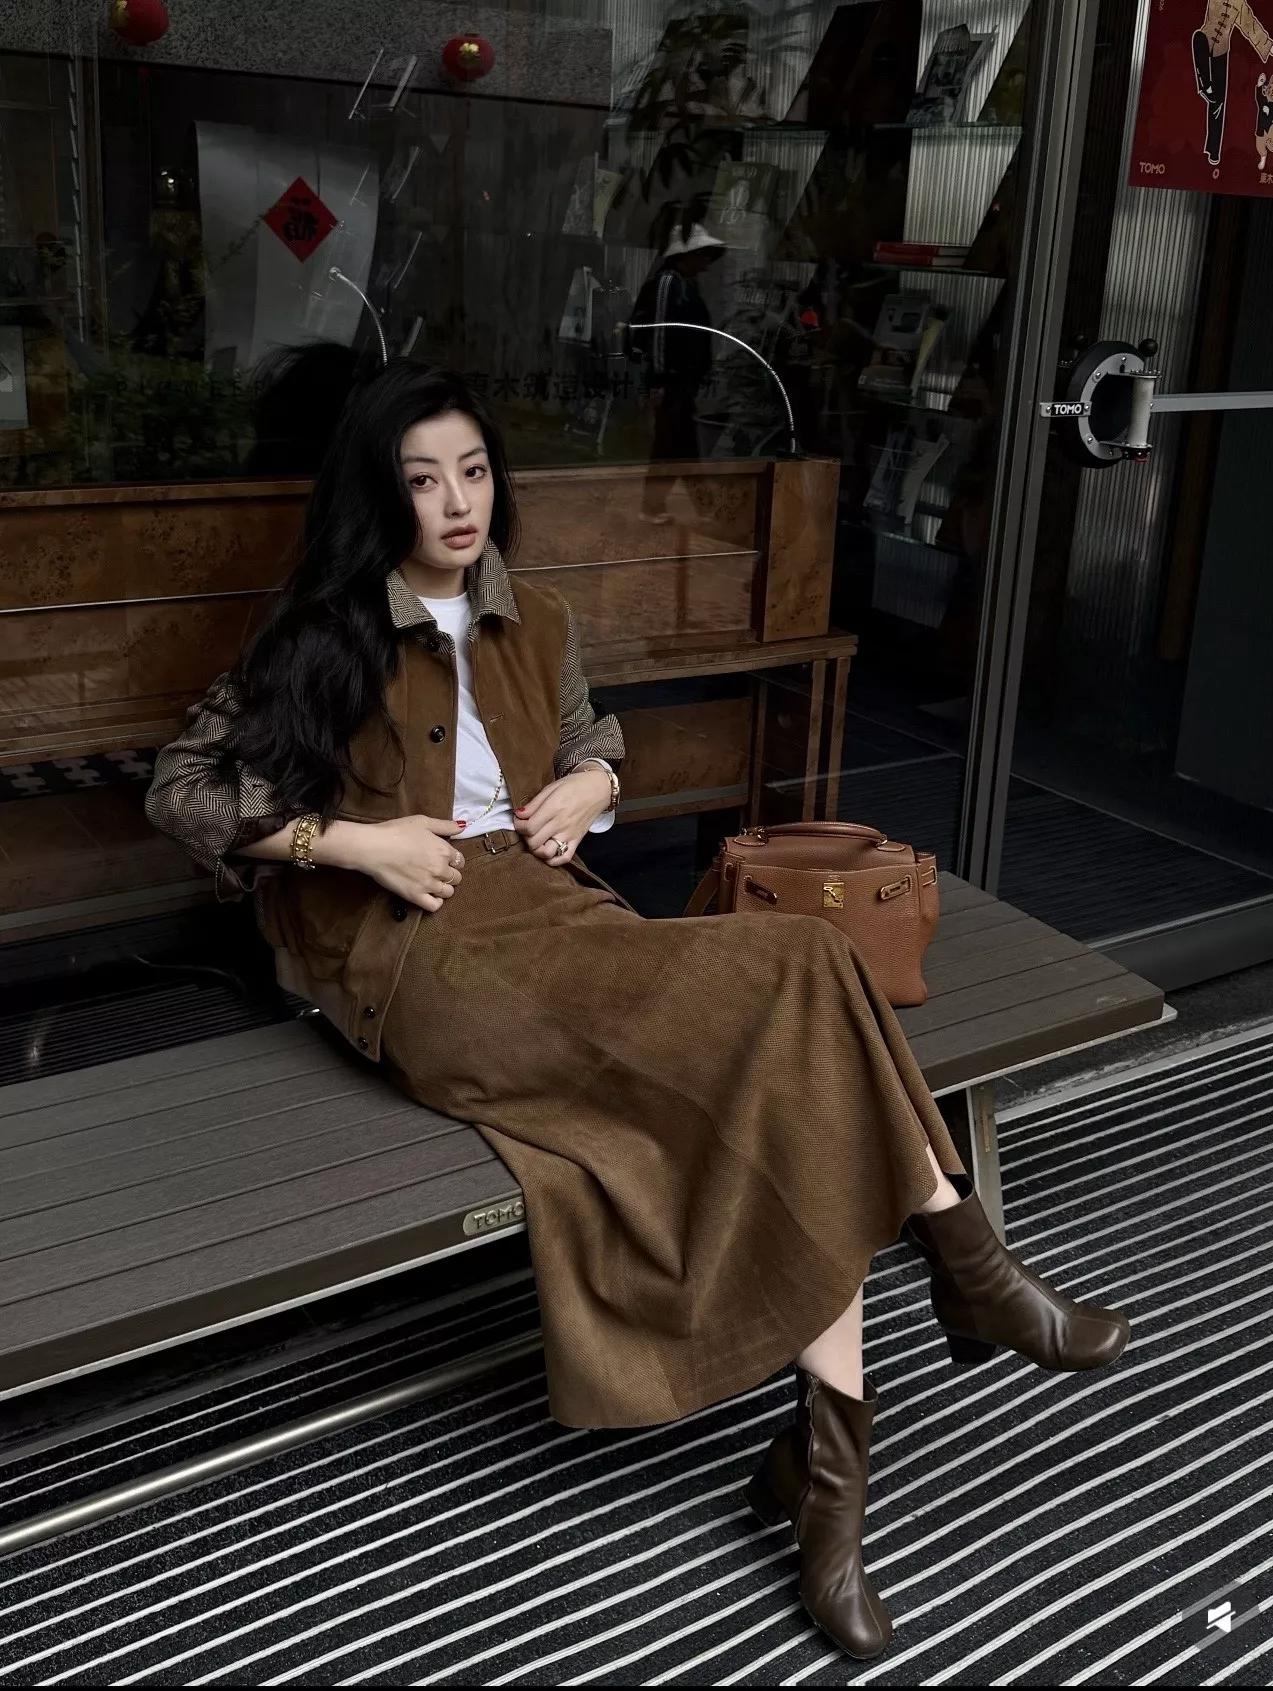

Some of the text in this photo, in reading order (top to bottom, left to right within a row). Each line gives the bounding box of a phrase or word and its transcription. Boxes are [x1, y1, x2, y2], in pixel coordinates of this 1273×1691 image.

[1139, 161, 1166, 175] TOMO
[1054, 404, 1082, 415] TOMO
[473, 1201, 525, 1229] TOMO
